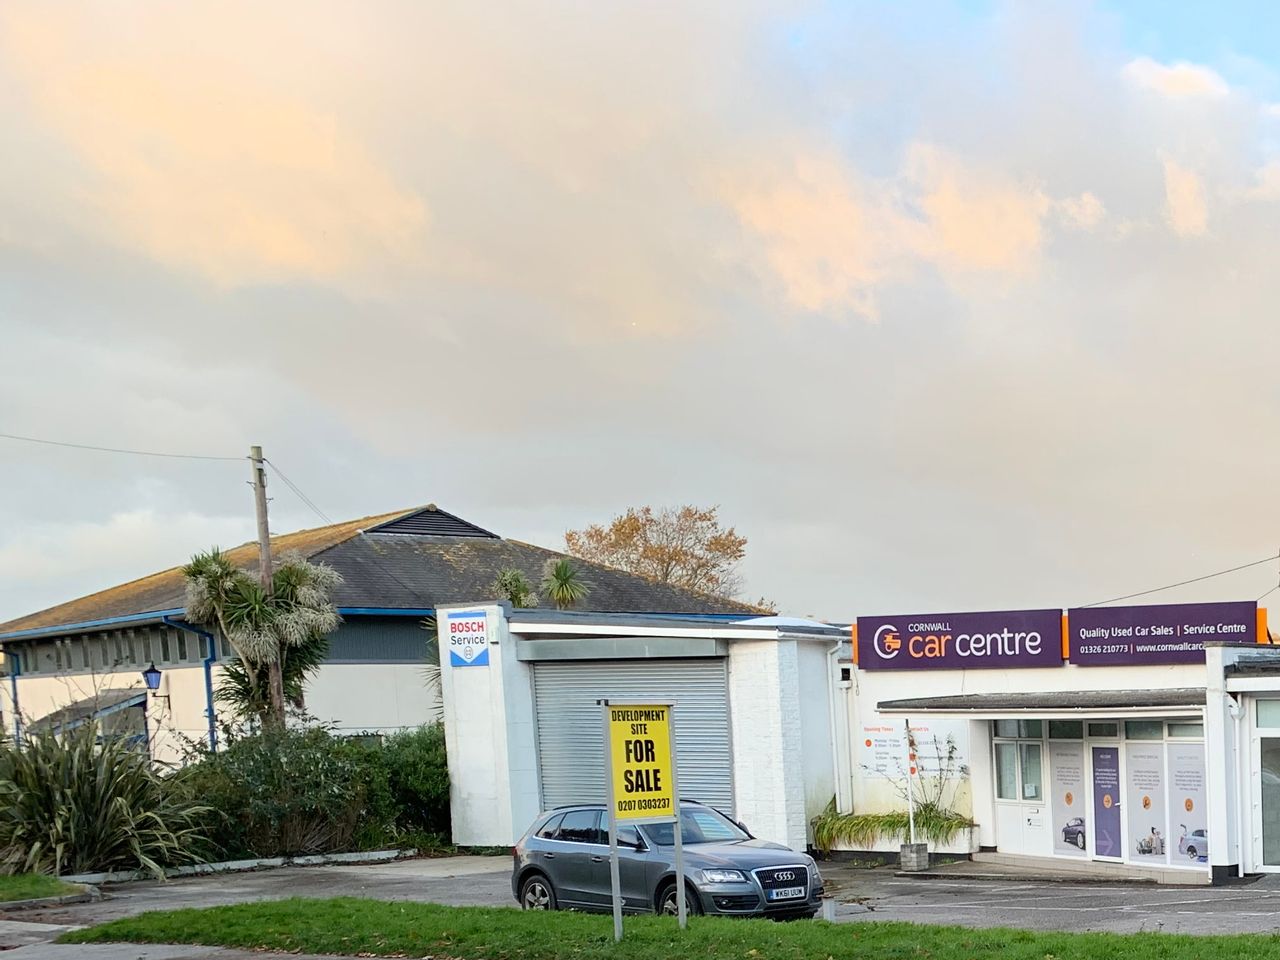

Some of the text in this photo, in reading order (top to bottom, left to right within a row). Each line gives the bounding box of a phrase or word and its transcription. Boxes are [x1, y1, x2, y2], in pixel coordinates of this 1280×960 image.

[450, 621, 485, 633] BOSCH
[908, 622, 952, 633] CORNWALL
[1079, 627, 1110, 640] Quality
[1111, 626, 1132, 637] Used
[1135, 626, 1149, 636] Car
[1150, 625, 1174, 636] Sales
[1183, 623, 1215, 635] Service
[1217, 623, 1247, 634] Centre
[450, 634, 485, 645] Service
[908, 627, 1042, 658] car centre
[1079, 645, 1102, 654] 01326
[1102, 644, 1128, 653] 210773
[611, 710, 665, 721] DEVELOPMENT
[631, 723, 648, 735] SITE
[624, 739, 655, 763] FOR
[624, 769, 662, 793] SALE
[618, 800, 636, 811] 0207
